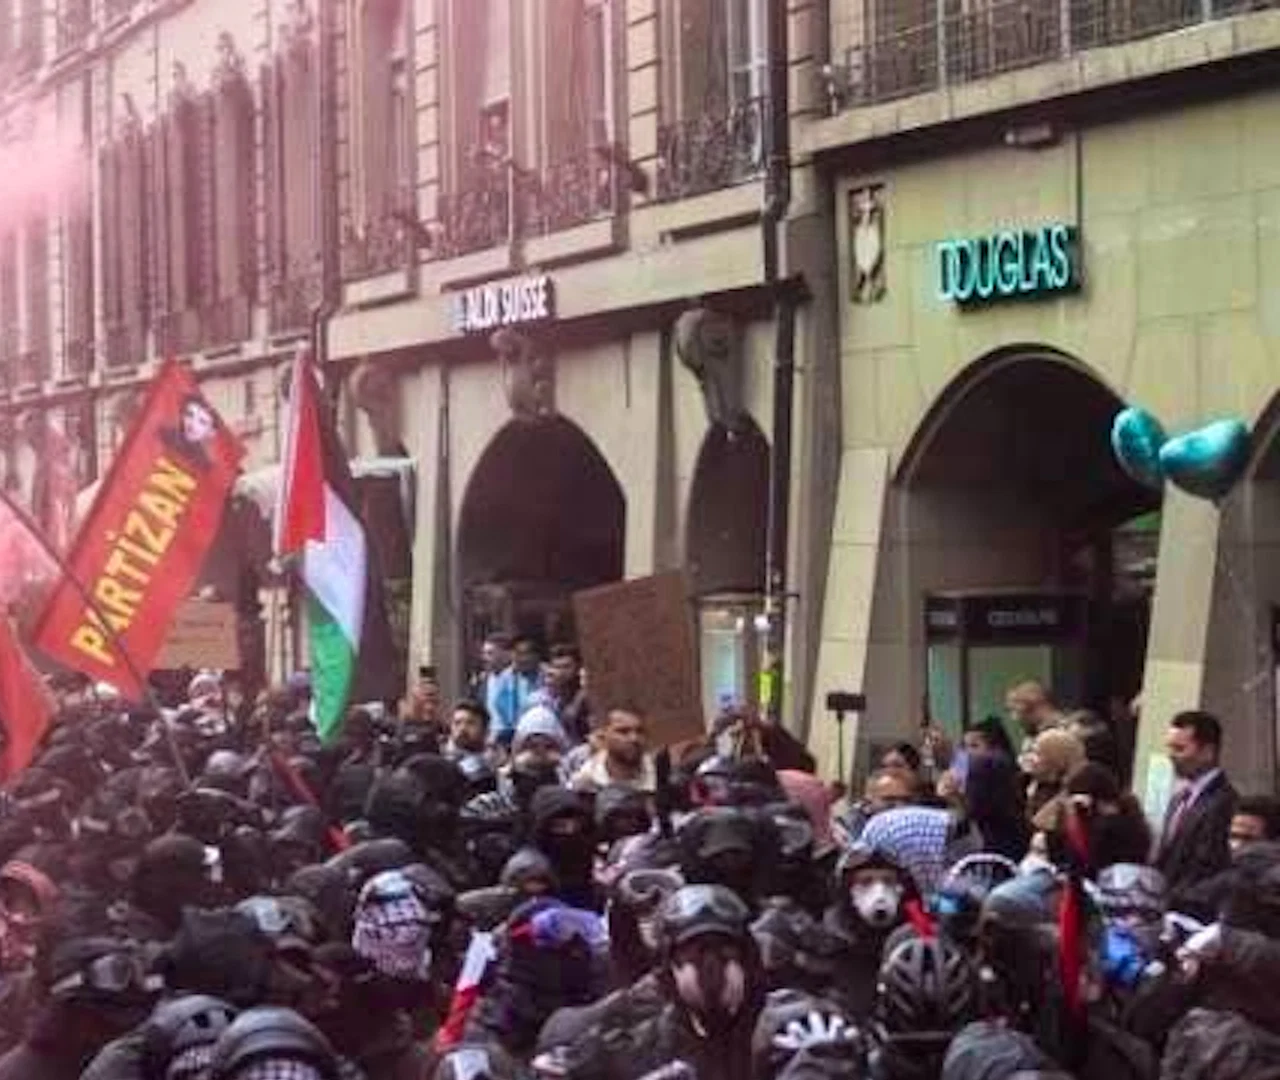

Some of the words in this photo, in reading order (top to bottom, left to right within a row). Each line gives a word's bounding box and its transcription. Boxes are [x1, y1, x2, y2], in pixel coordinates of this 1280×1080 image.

[936, 224, 1070, 300] DOUGLAS
[464, 285, 500, 331] ALDI
[502, 276, 548, 324] SUISSE
